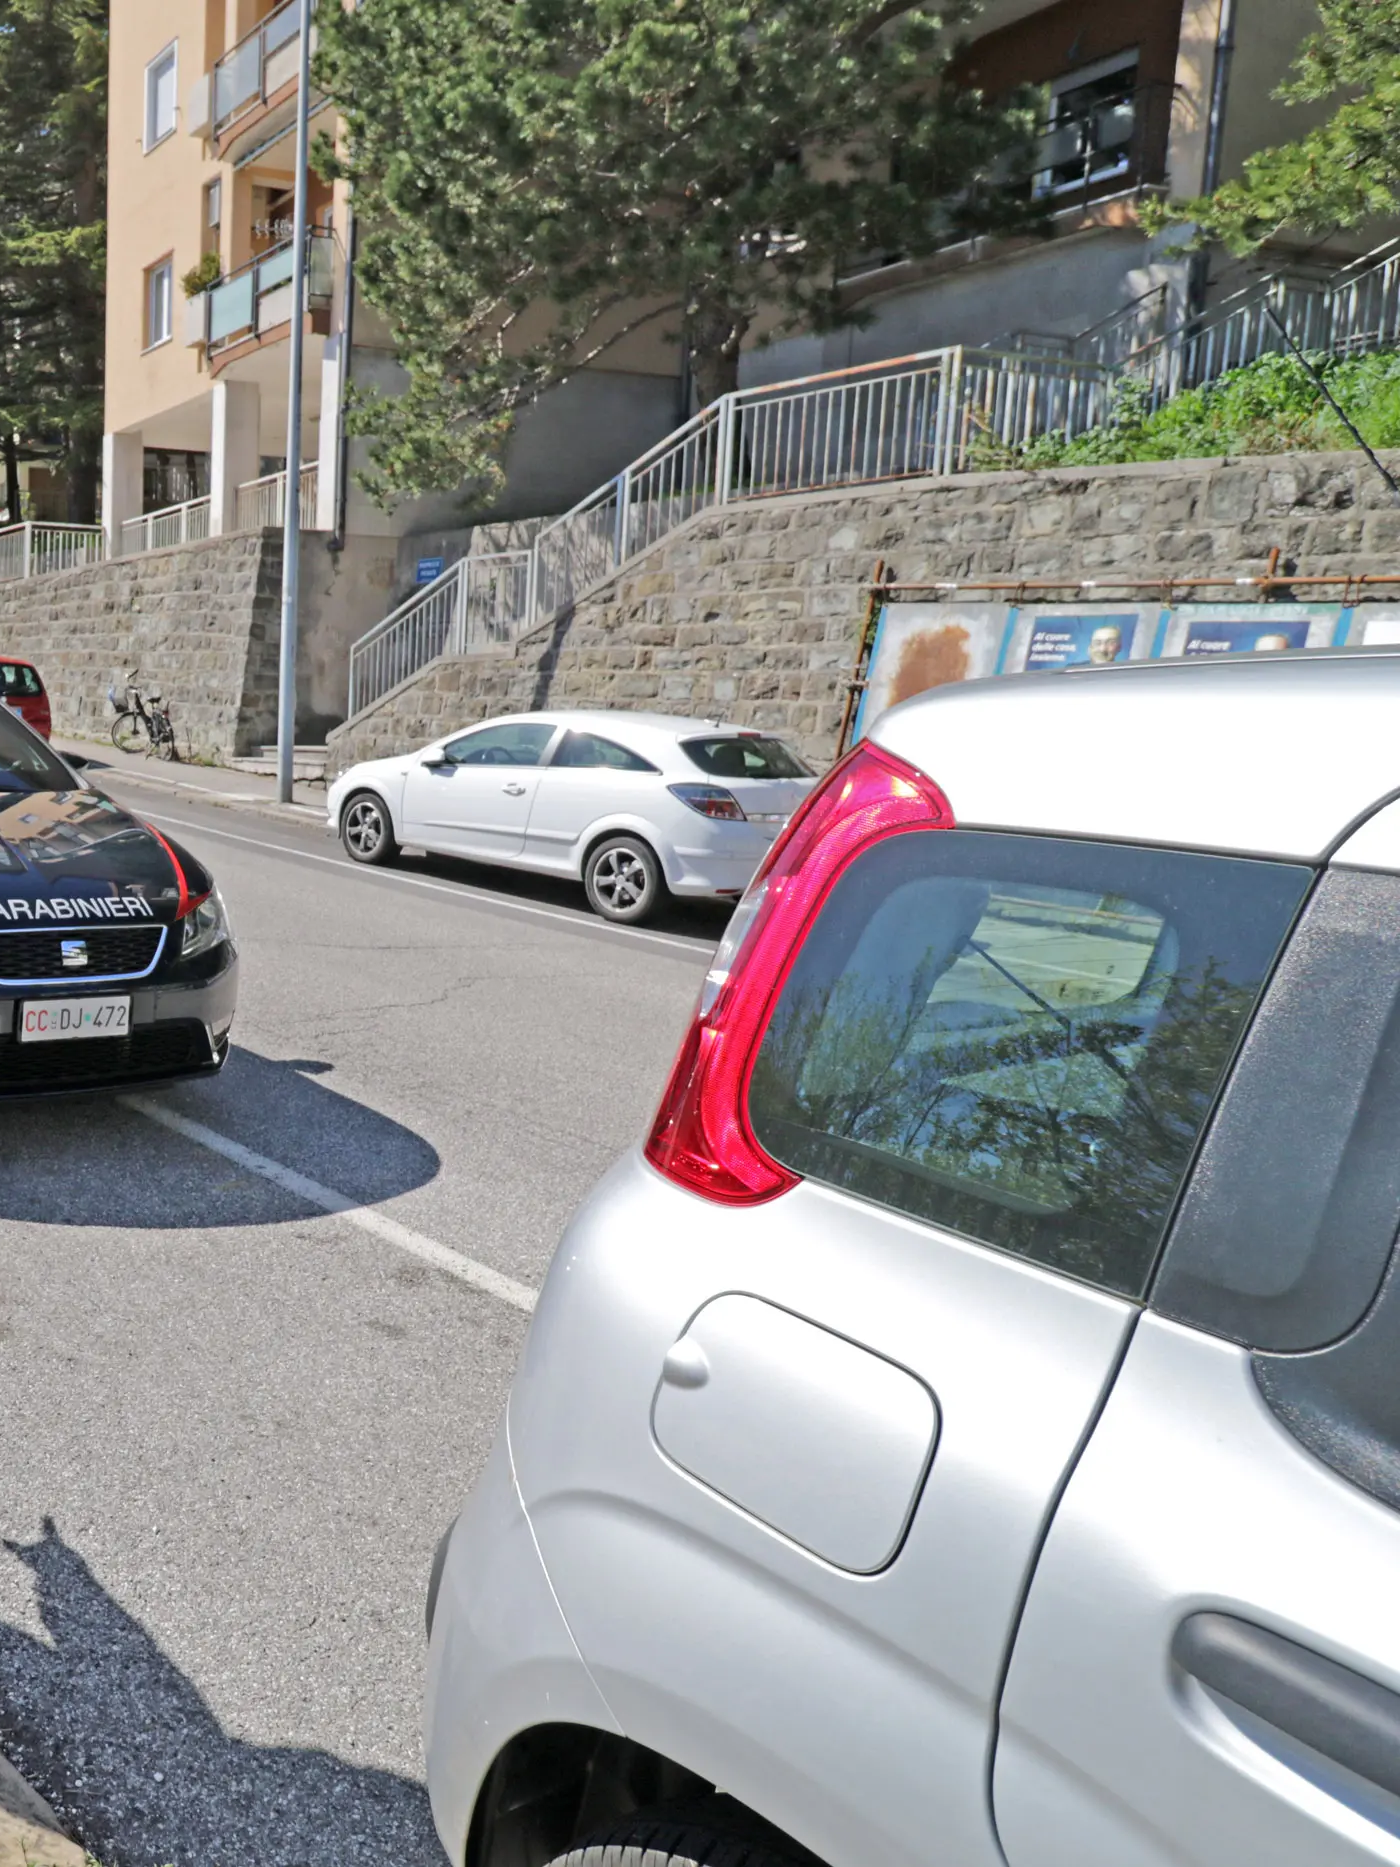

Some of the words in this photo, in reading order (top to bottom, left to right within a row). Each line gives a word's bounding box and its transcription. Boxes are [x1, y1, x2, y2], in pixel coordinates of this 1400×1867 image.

[25, 1010, 49, 1032] CC
[60, 1008, 83, 1030] DJ
[93, 1005, 127, 1028] 472
